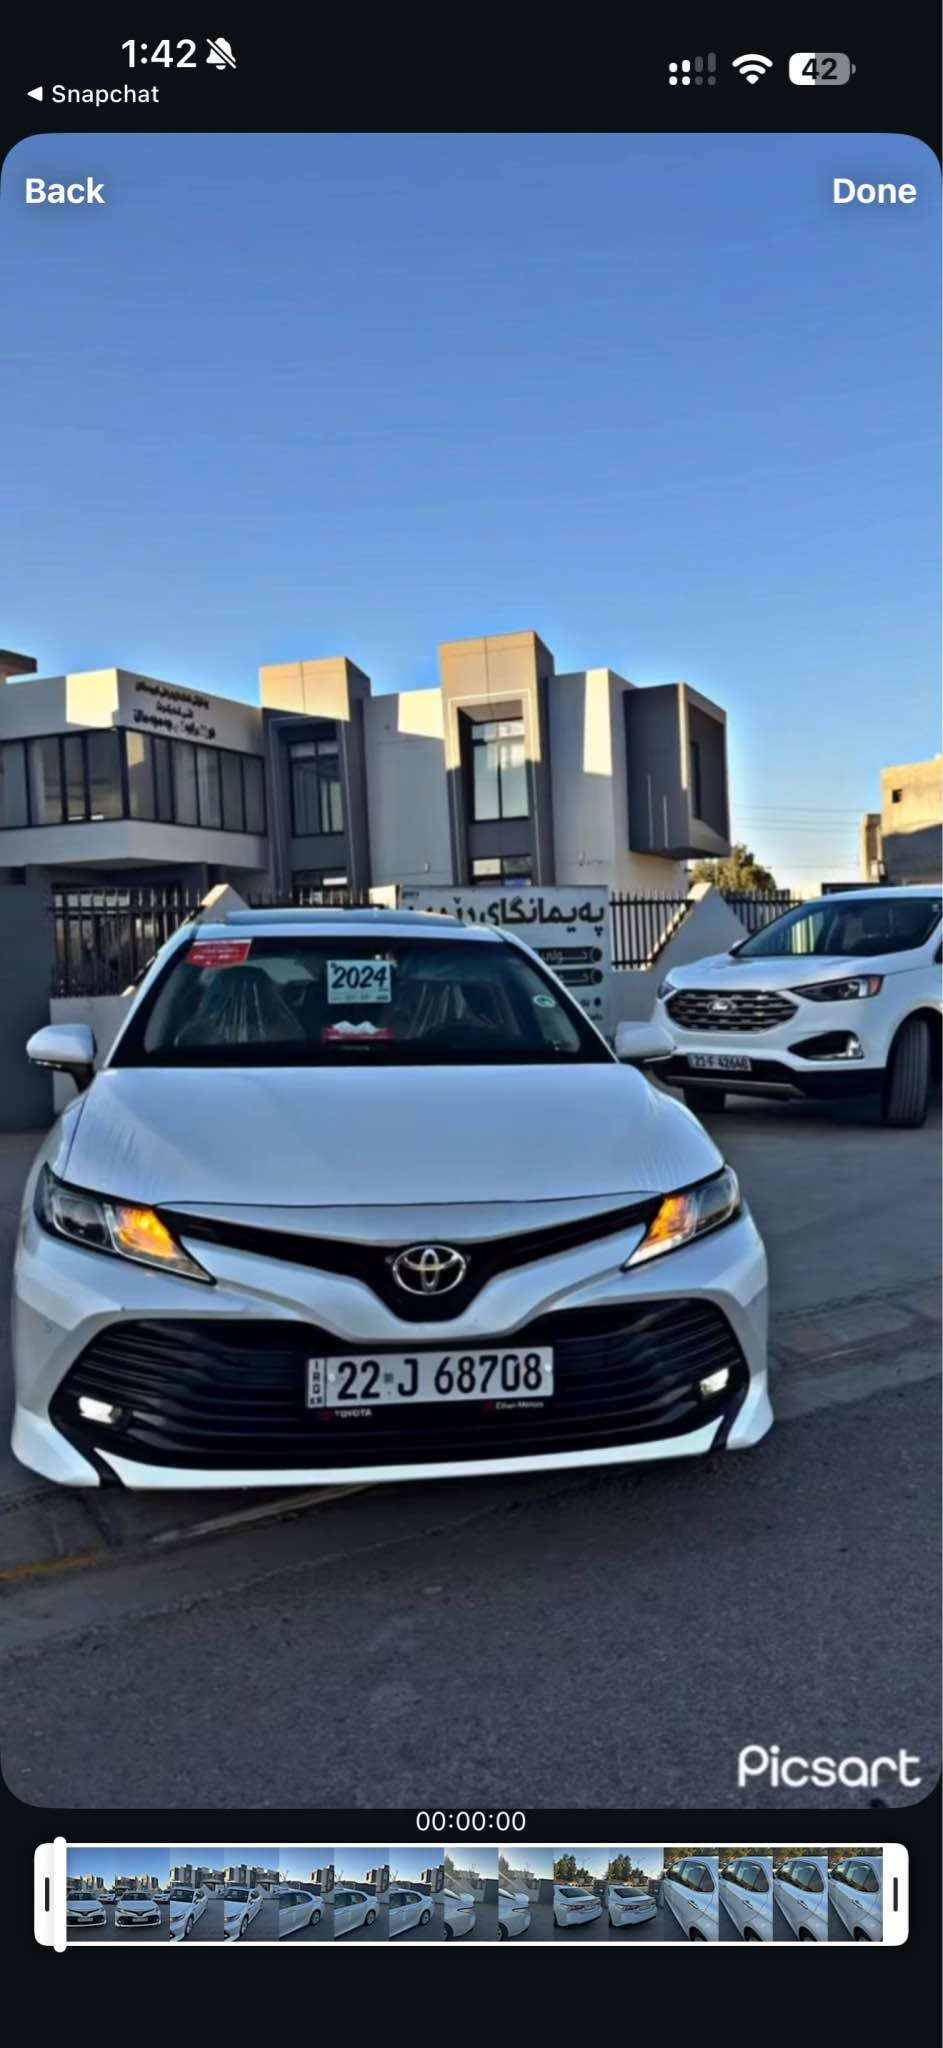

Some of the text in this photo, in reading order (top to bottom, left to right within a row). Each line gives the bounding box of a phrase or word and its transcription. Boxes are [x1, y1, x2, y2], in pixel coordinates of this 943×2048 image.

[331, 965, 388, 989] 2024
[337, 1353, 543, 1400] 22 J 68708
